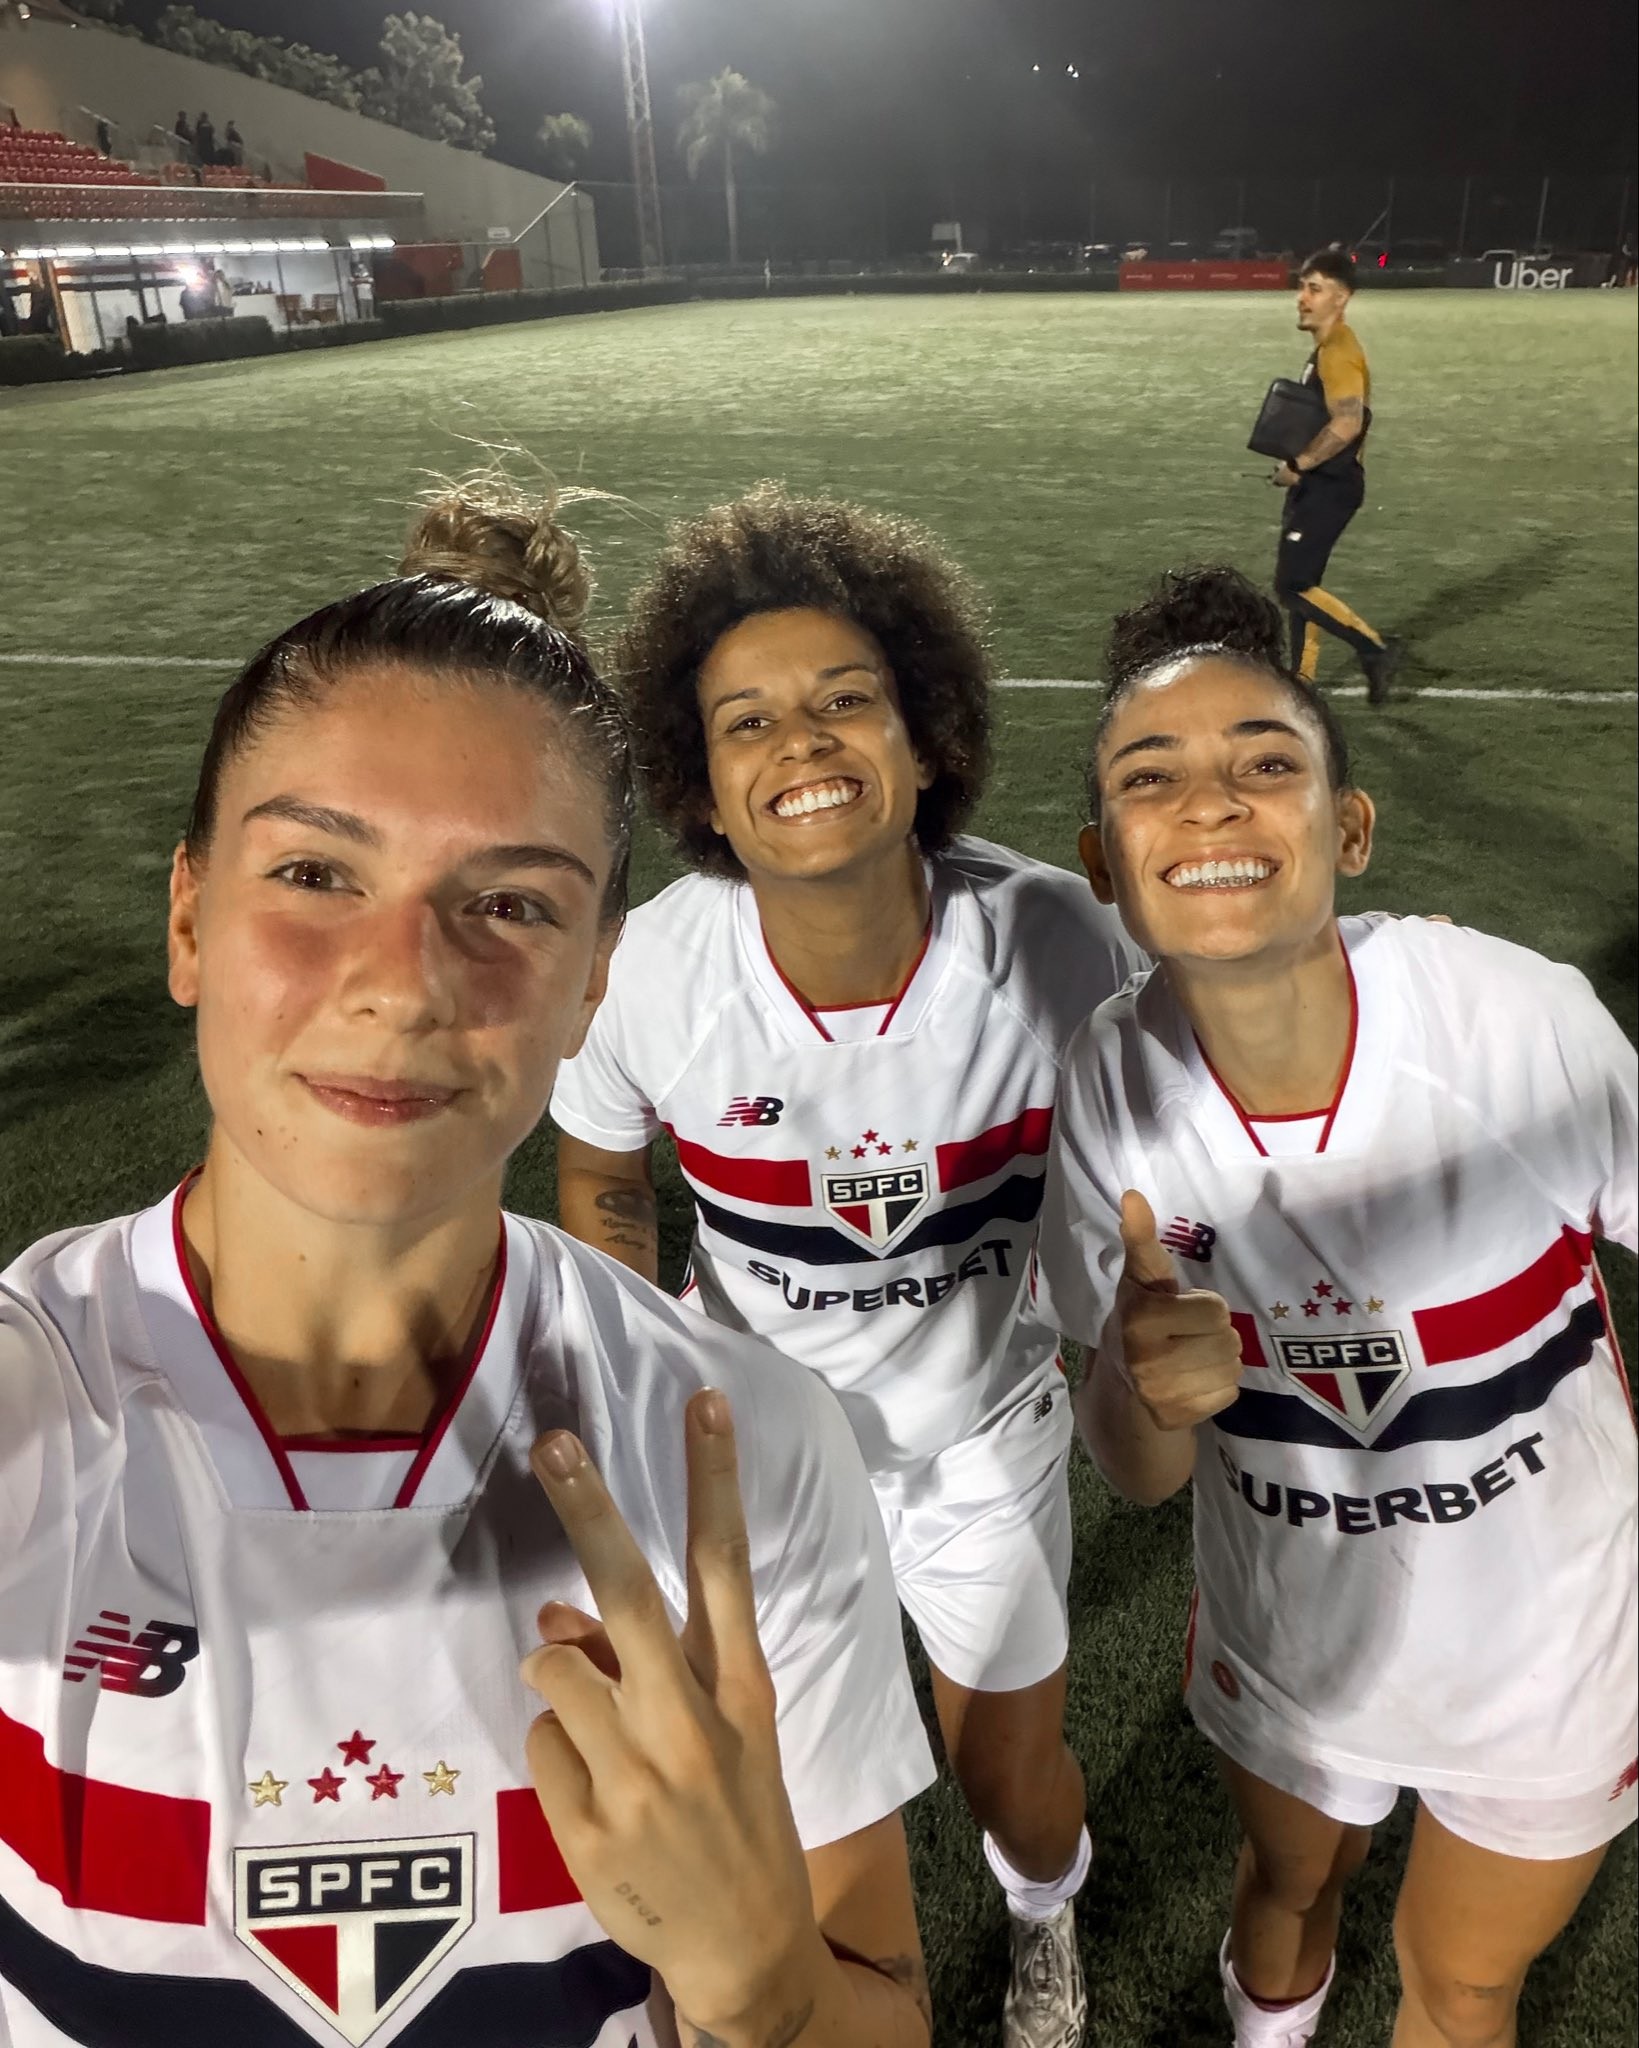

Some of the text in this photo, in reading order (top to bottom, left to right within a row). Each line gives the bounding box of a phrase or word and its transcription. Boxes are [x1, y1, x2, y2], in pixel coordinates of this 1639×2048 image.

[1494, 261, 1574, 289] Uber
[832, 1174, 919, 1200] SPFC
[747, 1238, 1012, 1313] SUPERBET
[1287, 1341, 1396, 1366] SPFC
[1218, 1431, 1547, 1536] SUPERBET
[258, 1856, 453, 1911] SPFC
